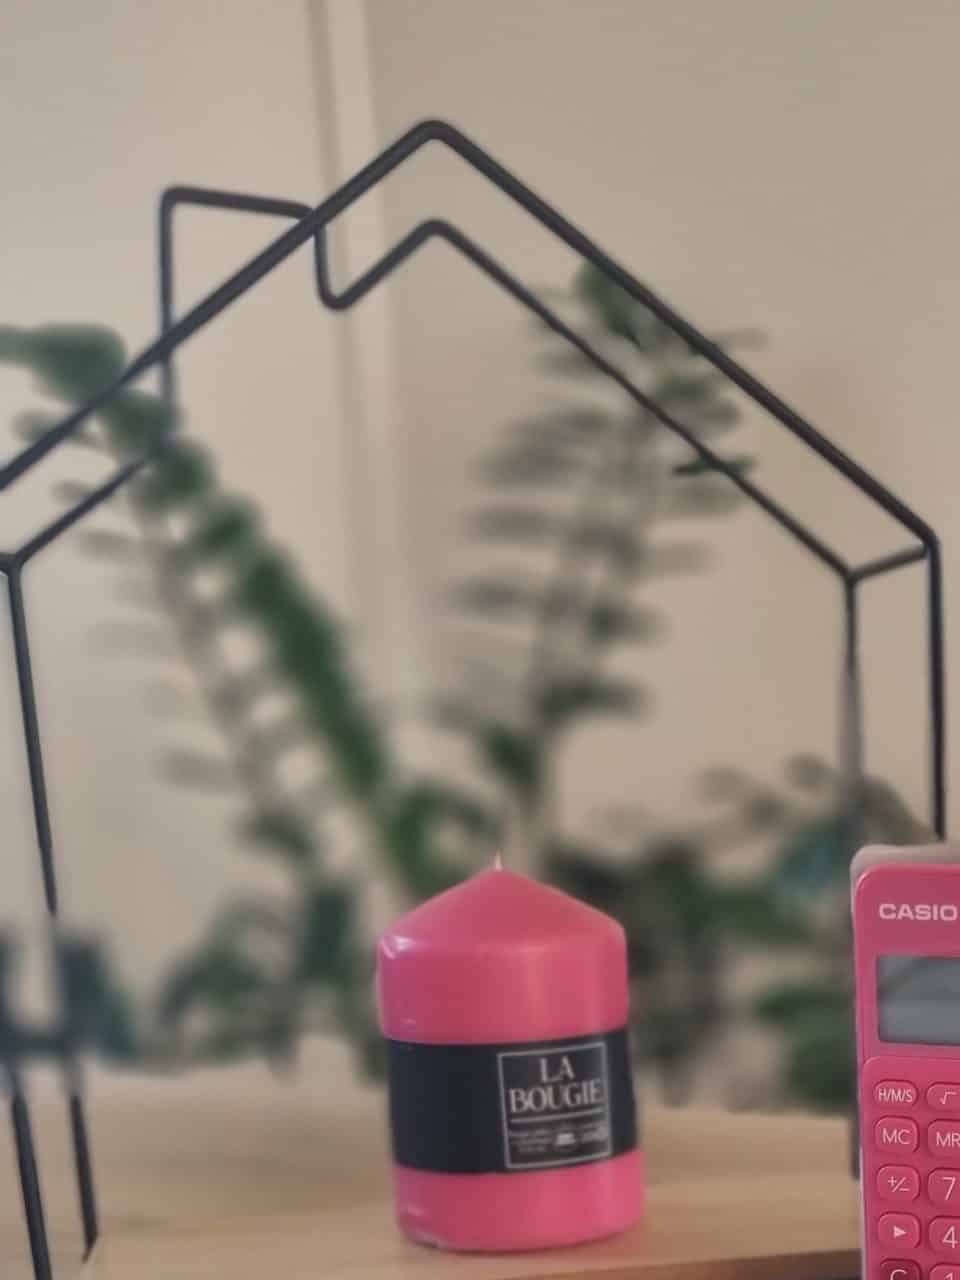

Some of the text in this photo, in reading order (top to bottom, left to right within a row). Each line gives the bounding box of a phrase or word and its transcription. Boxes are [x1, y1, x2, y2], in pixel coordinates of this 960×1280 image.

[879, 903, 958, 921] CASIO
[540, 1055, 575, 1083] LA
[508, 1078, 603, 1114] BOUGIE
[878, 1088, 913, 1103] H/M/S
[882, 1128, 911, 1145] MC
[943, 1176, 957, 1201] 7
[942, 1226, 958, 1249] 4
